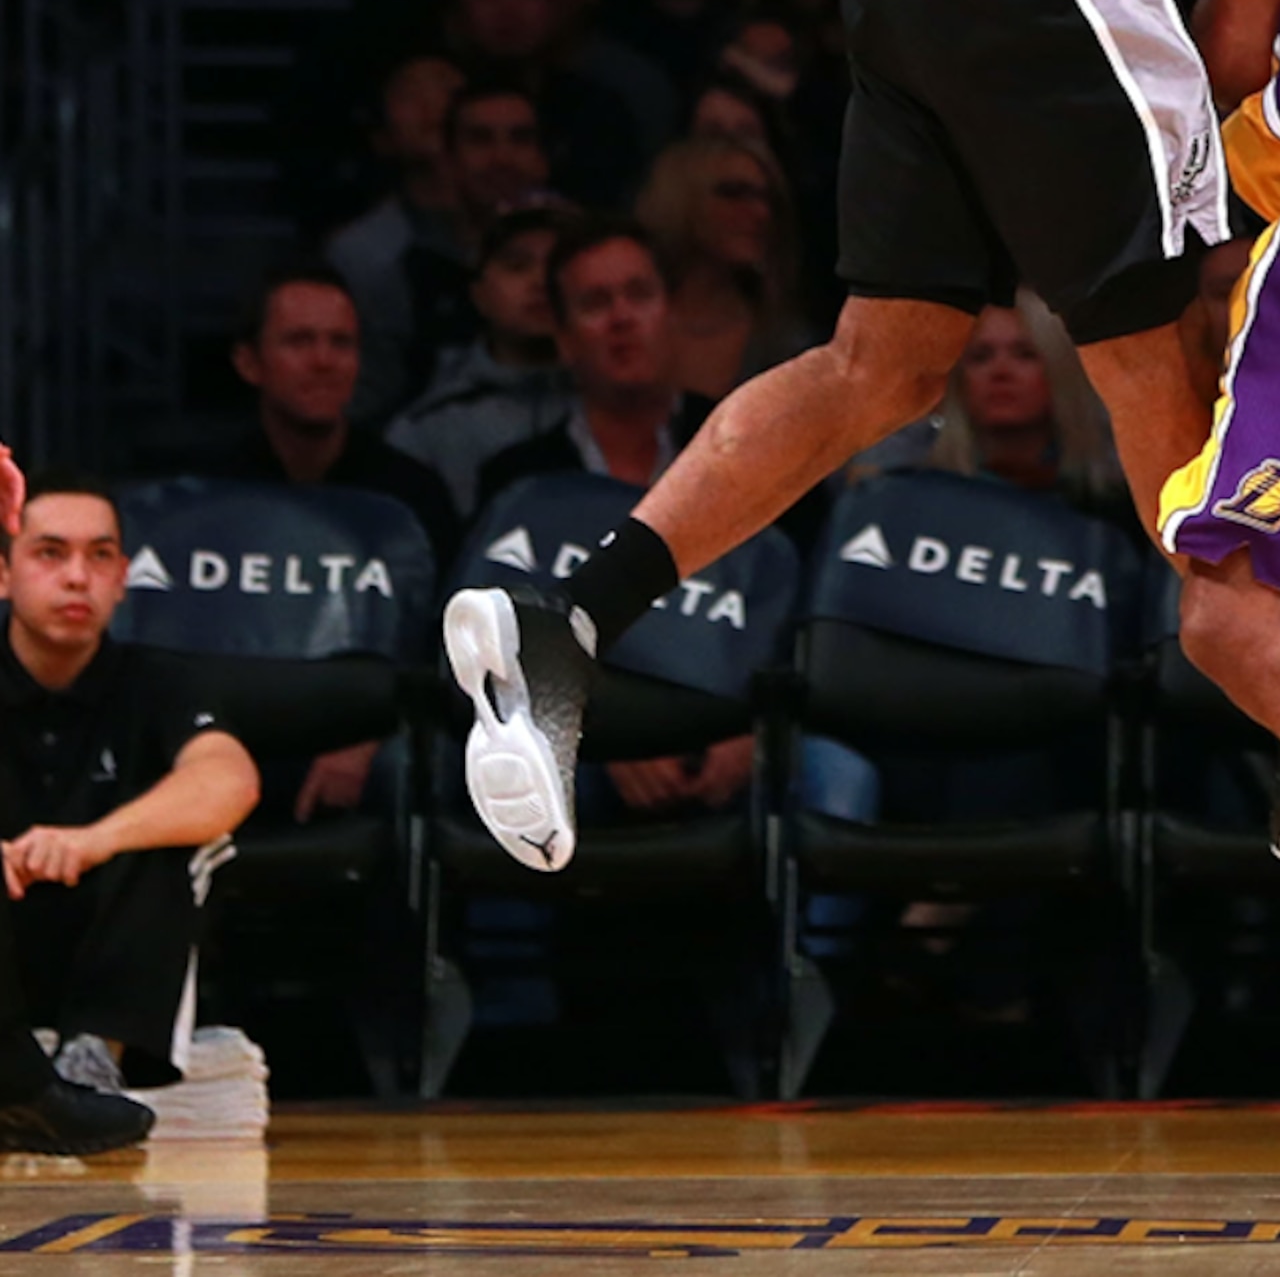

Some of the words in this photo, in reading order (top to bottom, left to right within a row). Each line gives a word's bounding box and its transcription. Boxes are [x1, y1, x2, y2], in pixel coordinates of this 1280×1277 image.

[189, 549, 394, 599] DELTA
[552, 542, 746, 631] DTA
[907, 535, 1108, 610] DELTA
